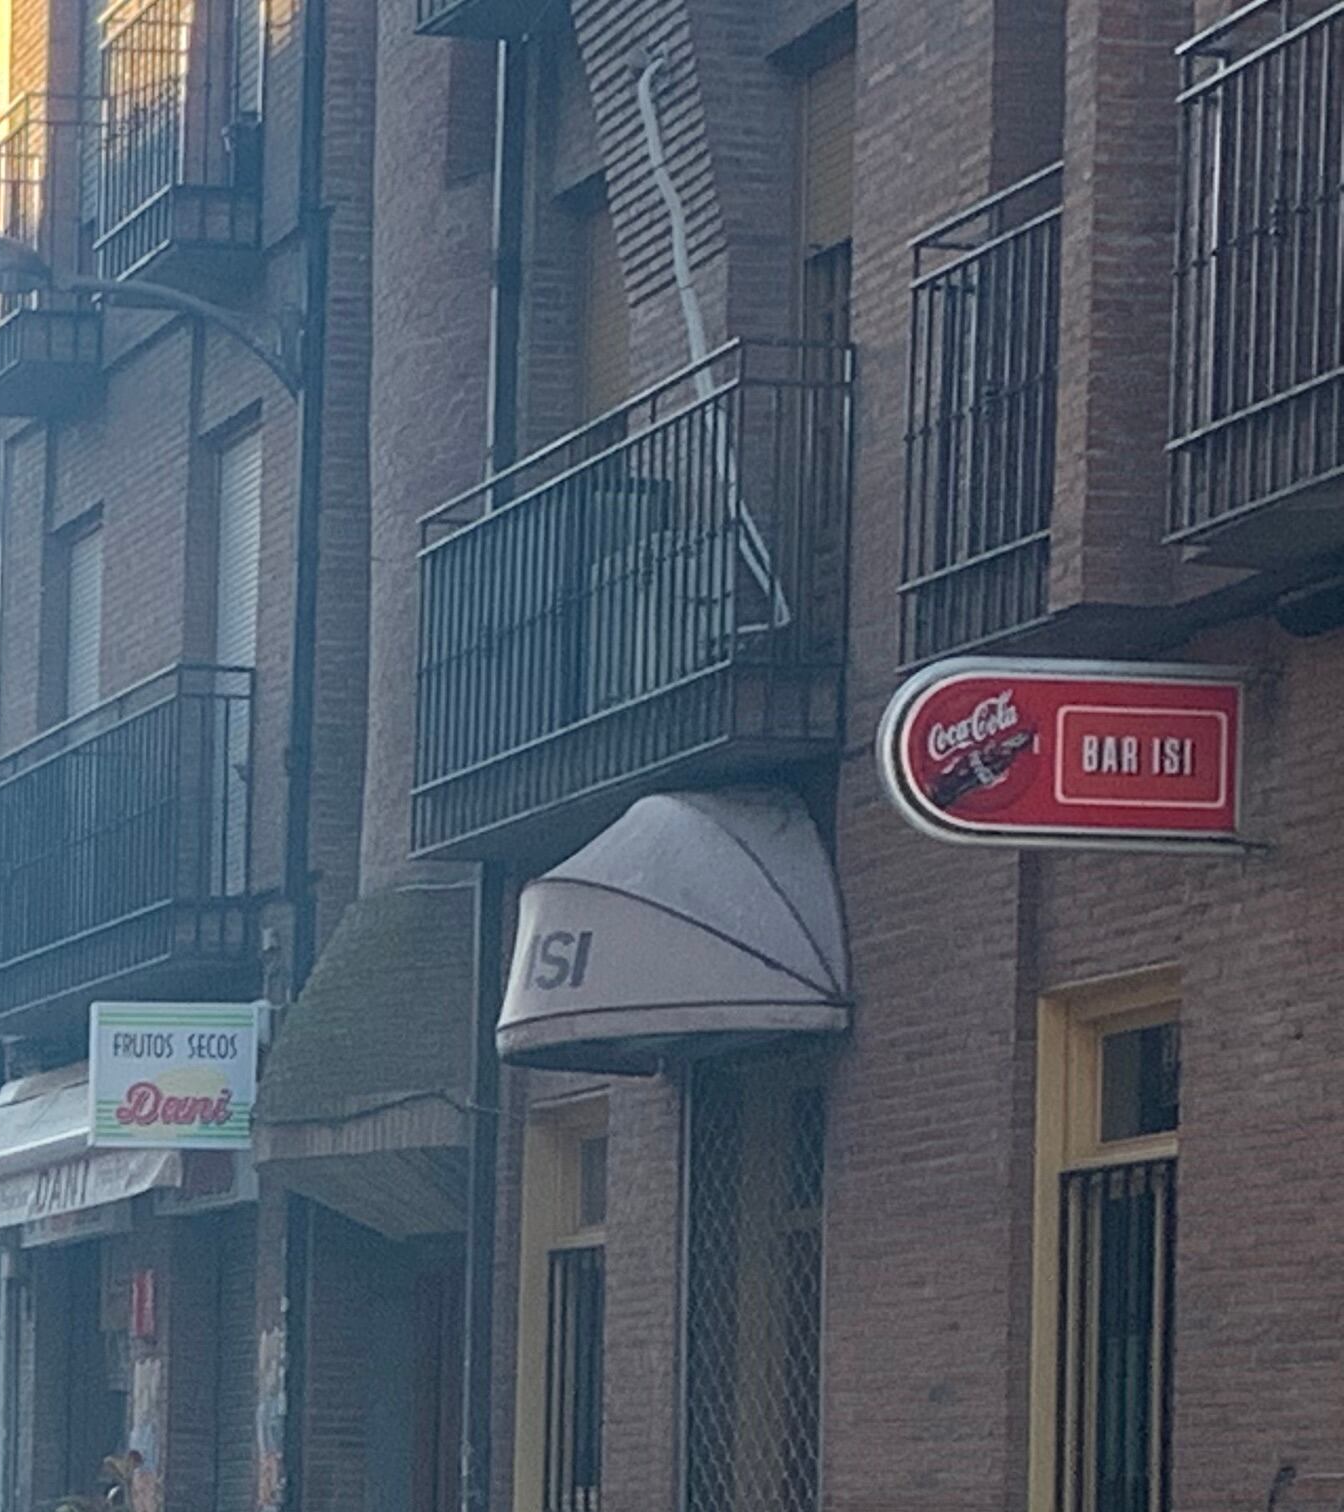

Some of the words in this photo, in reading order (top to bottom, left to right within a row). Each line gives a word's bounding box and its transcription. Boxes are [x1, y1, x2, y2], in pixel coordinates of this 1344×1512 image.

[927, 689, 1018, 761] Coca-Cola
[1081, 735, 1139, 774] BAR
[1151, 736, 1193, 776] ISI
[113, 1032, 174, 1059] FRUTOS
[187, 1032, 238, 1059] SECOS
[115, 1081, 233, 1125] Dani
